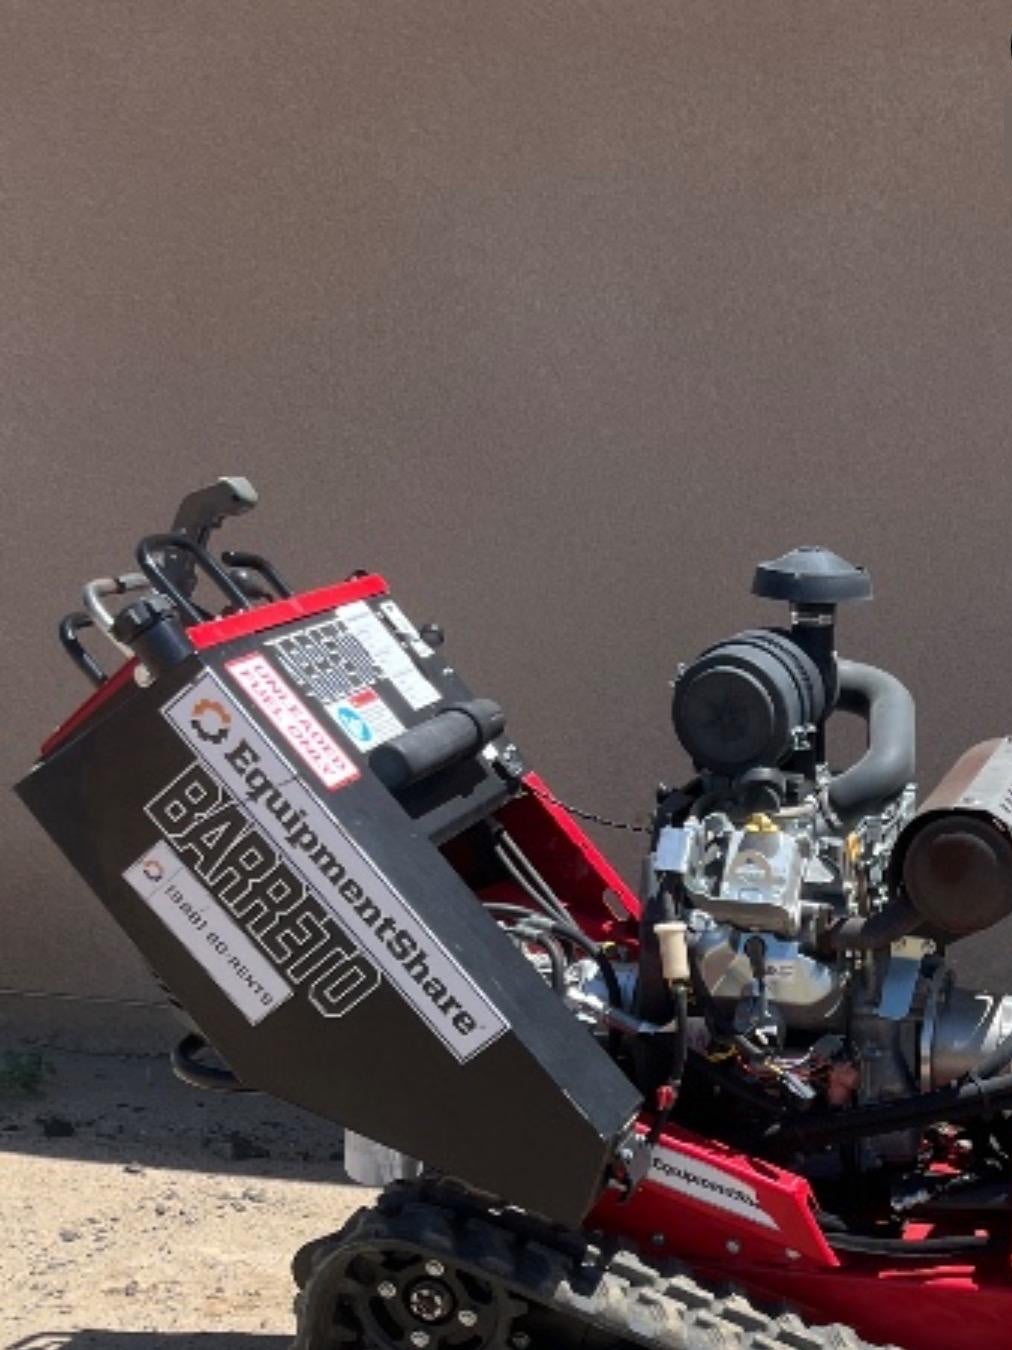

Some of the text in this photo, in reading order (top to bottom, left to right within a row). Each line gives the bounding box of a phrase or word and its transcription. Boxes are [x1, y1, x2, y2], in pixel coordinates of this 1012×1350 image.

[239, 670, 283, 716] FUEL
[286, 724, 337, 775] ONLY
[254, 664, 346, 770] UNLEADED
[143, 760, 382, 1018] BARRETO
[224, 739, 478, 1037] EquipmentShare
